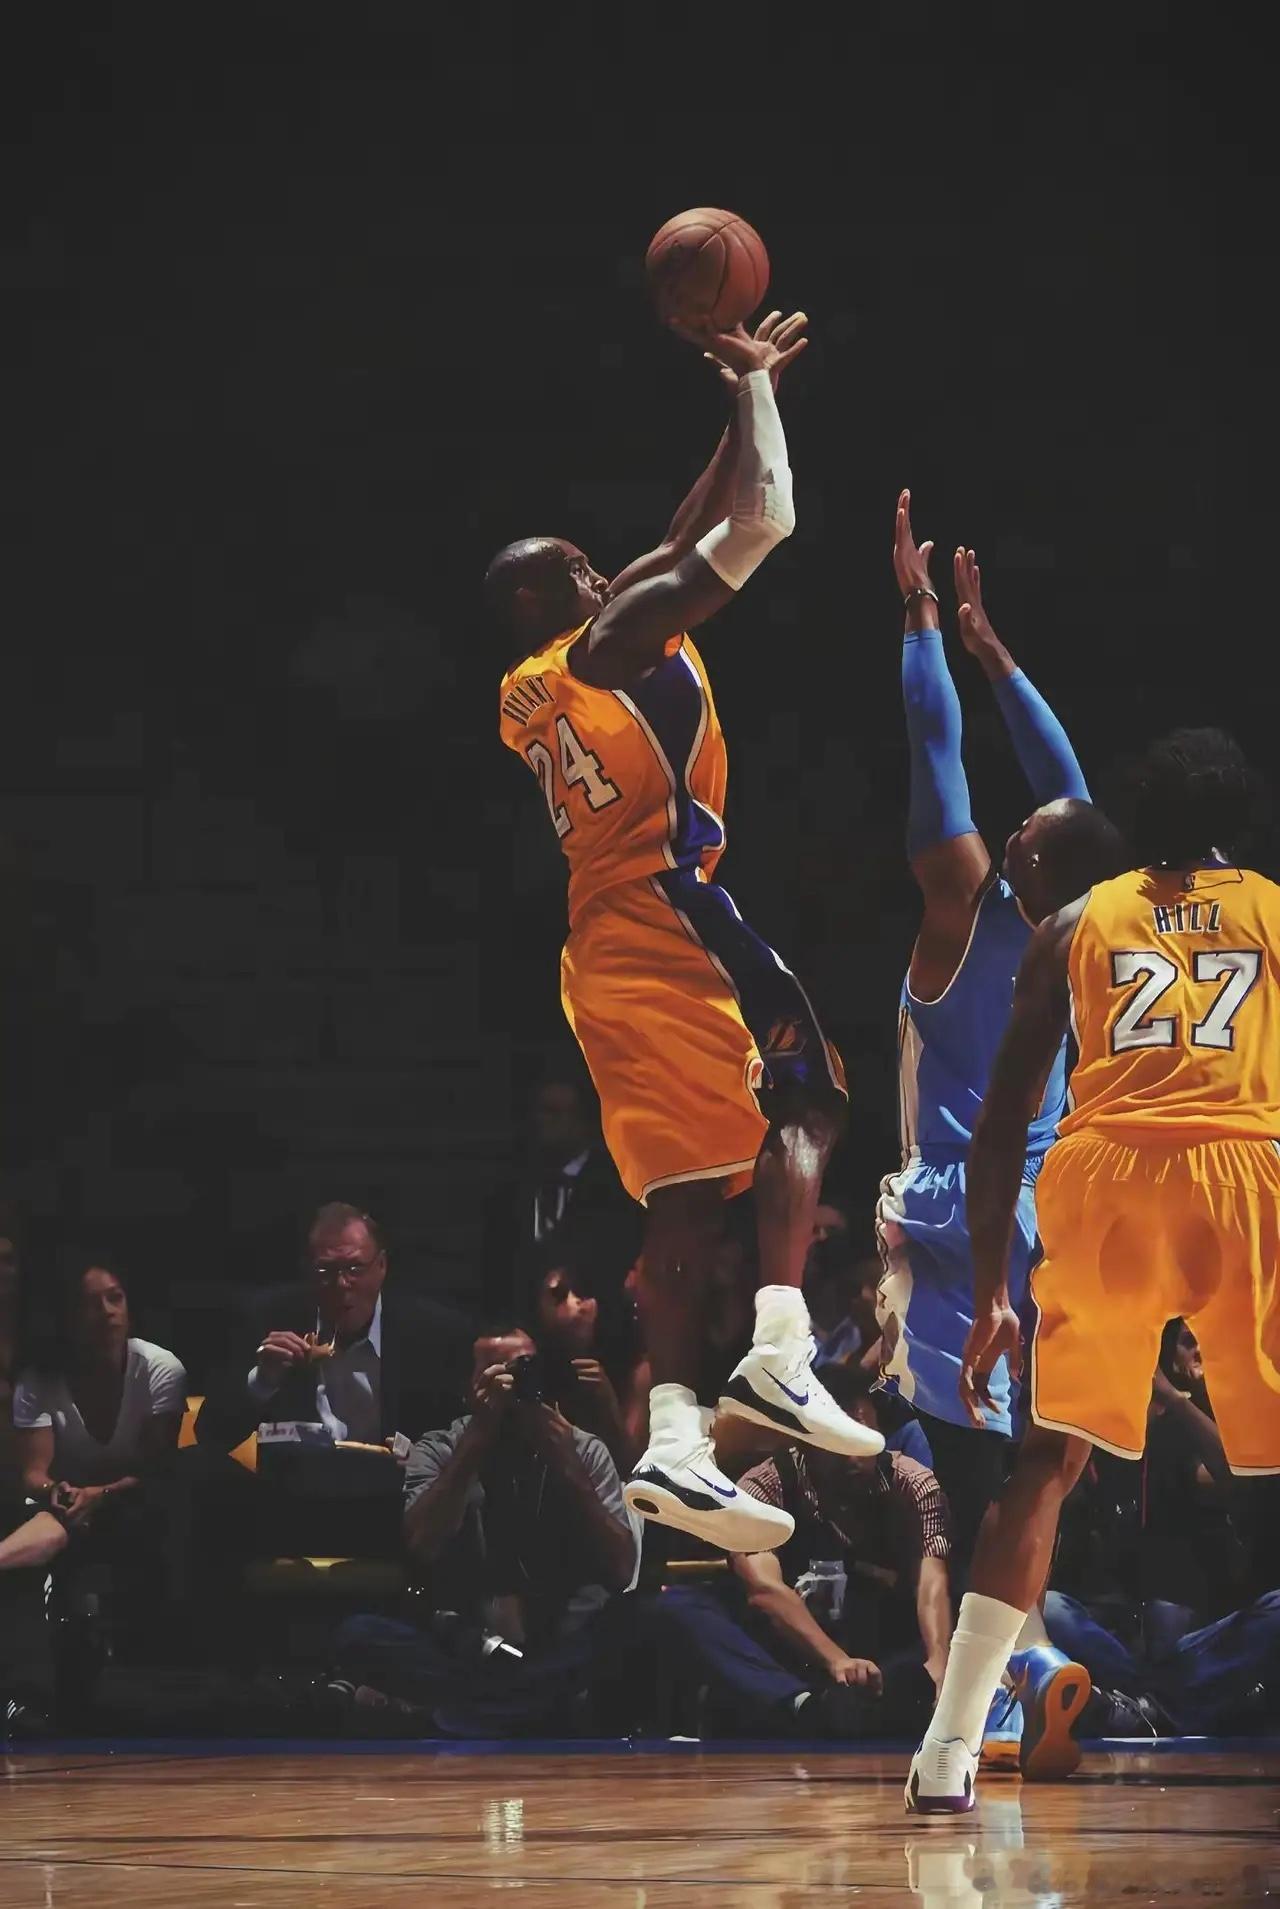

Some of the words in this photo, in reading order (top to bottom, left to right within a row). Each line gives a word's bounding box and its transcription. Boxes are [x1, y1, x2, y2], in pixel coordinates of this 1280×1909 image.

[526, 713, 623, 838] 24
[1153, 902, 1222, 934] HILL
[1110, 950, 1264, 1056] 27
